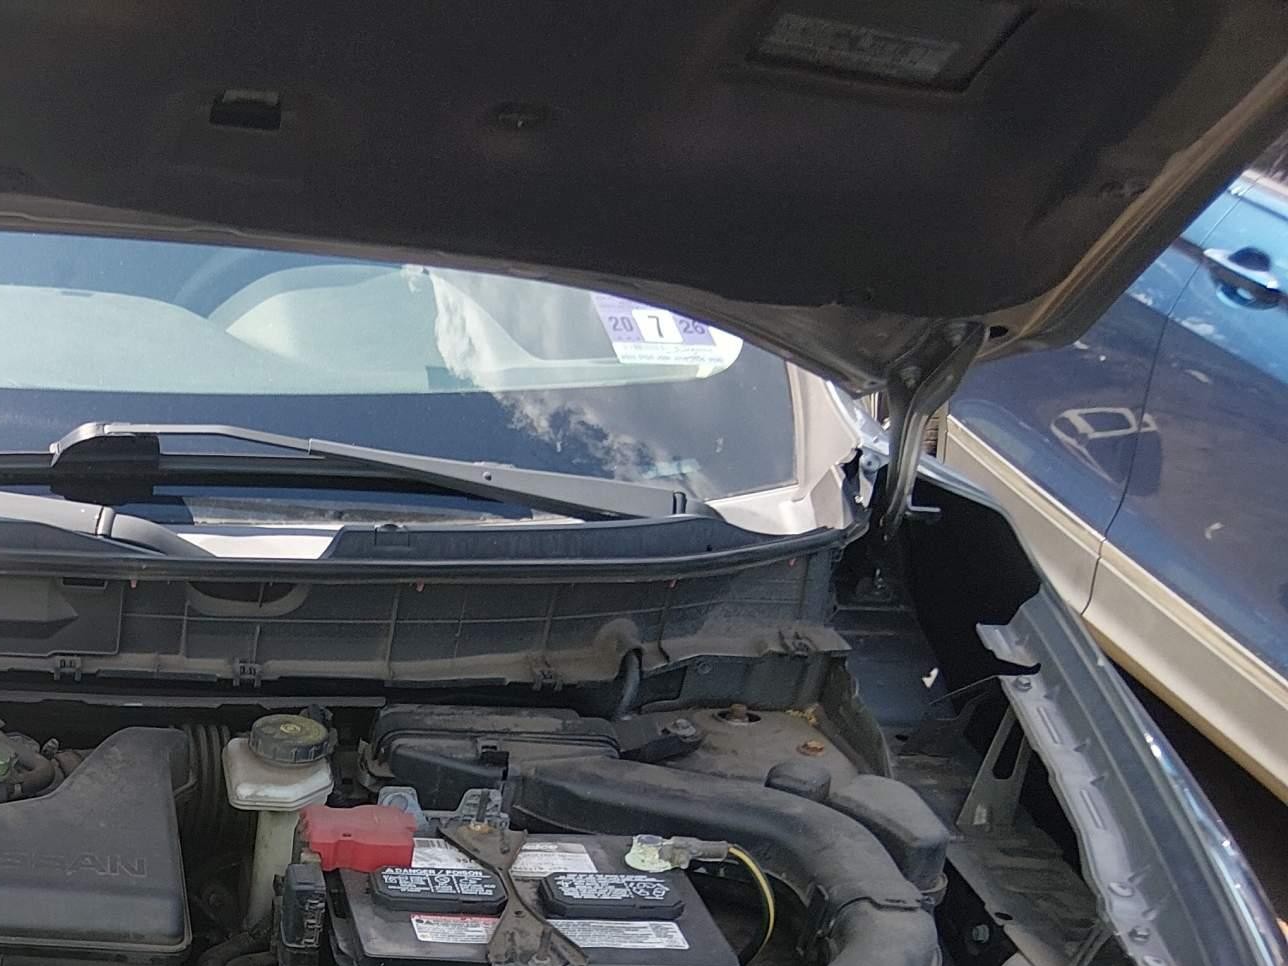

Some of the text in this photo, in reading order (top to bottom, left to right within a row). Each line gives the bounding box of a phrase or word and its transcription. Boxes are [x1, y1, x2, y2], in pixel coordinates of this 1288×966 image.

[607, 314, 706, 339] 20 7 26
[394, 867, 436, 875] DANGER
